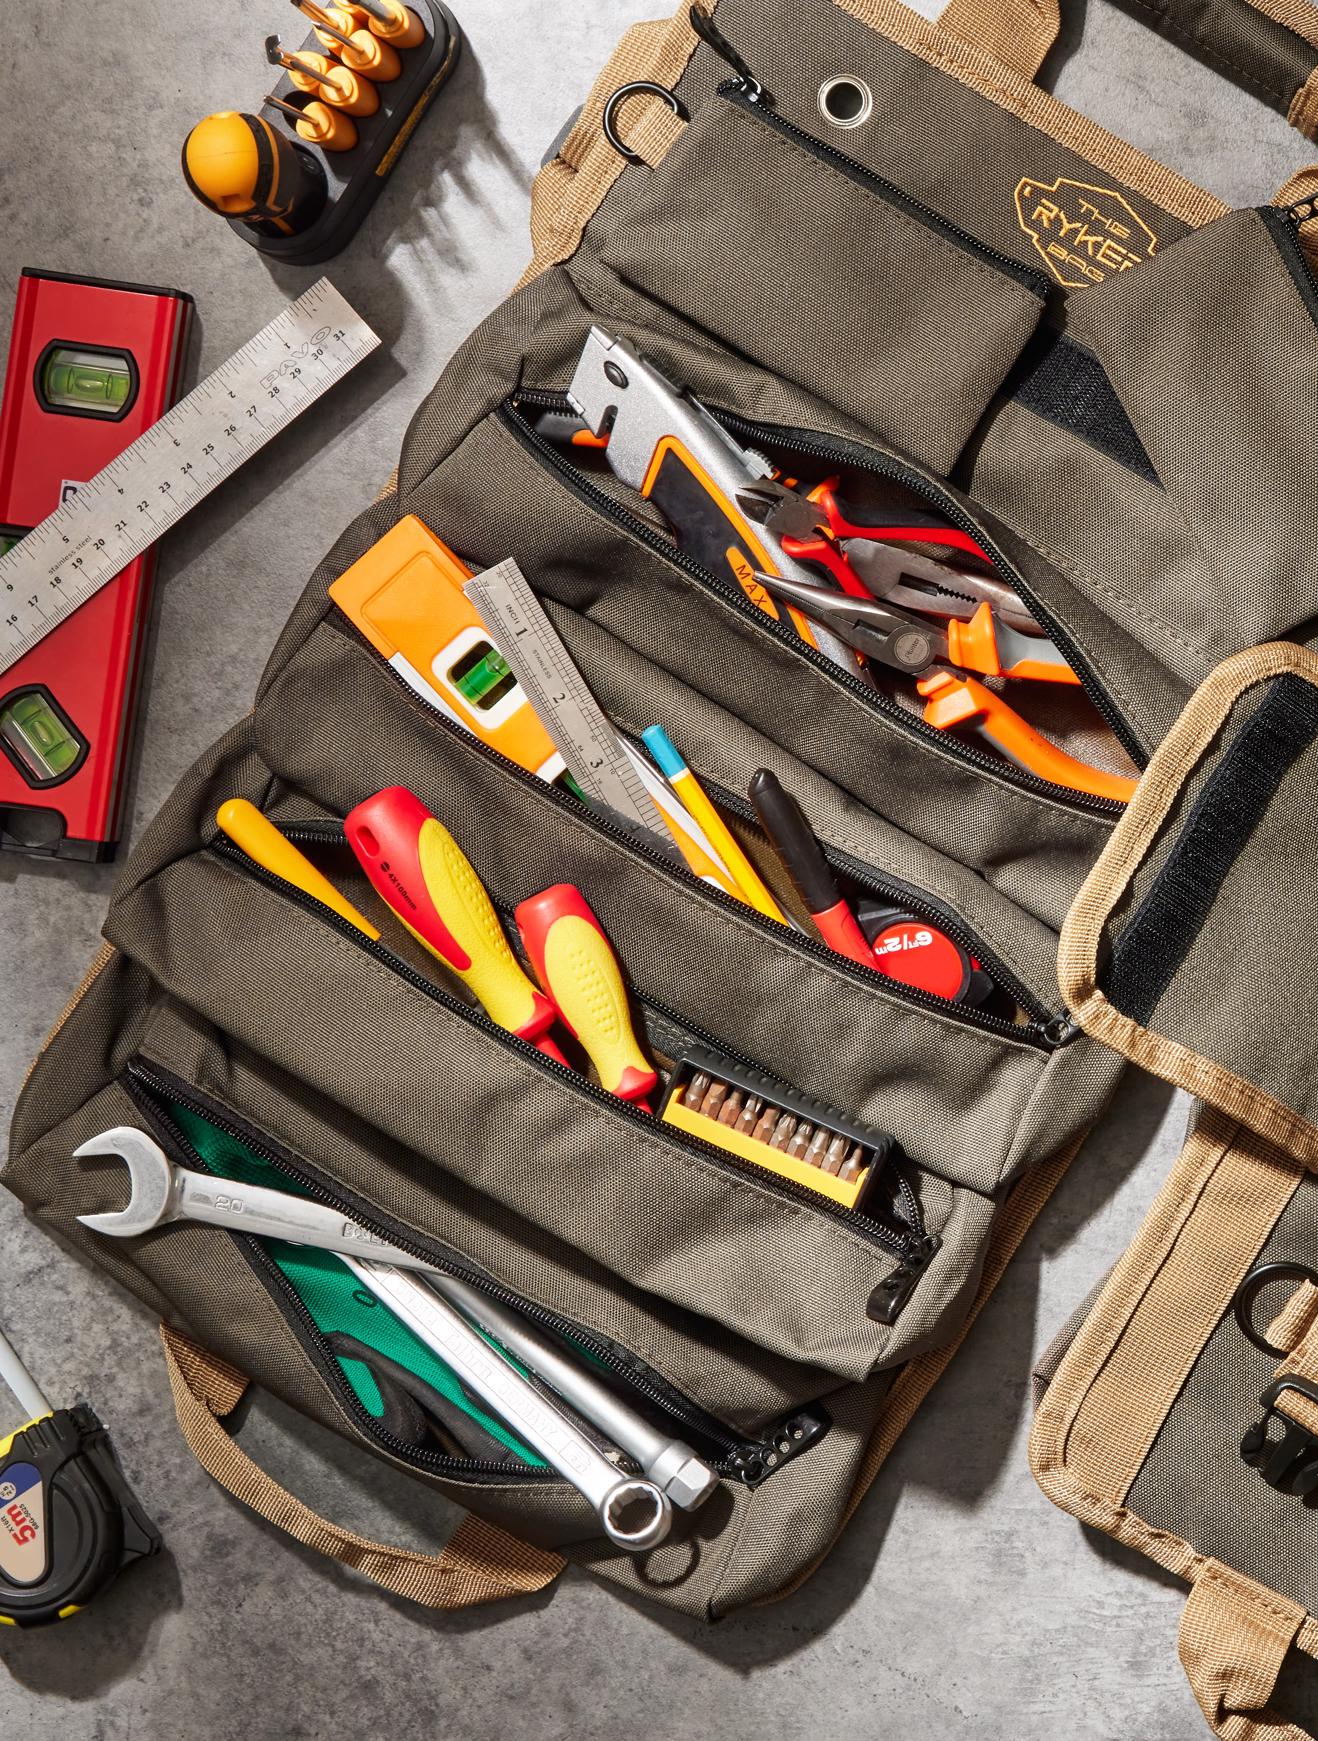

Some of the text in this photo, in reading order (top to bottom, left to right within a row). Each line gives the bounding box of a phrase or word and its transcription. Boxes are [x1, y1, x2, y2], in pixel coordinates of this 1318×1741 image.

[1079, 199, 1131, 239] THE
[1047, 242, 1105, 283] BAG
[259, 326, 332, 390] PAVO
[5, 329, 346, 627] 16 17 18 19 20 21 22 23 24 25 26 27 28 29 30 31
[48, 535, 92, 575] stainless steel
[735, 564, 767, 607] MAX
[505, 603, 520, 625] INCH
[532, 649, 552, 679] STAINLESS
[515, 627, 604, 769] 1 2 3
[215, 1194, 244, 1214] 20
[6, 1504, 36, 1547] 5m
